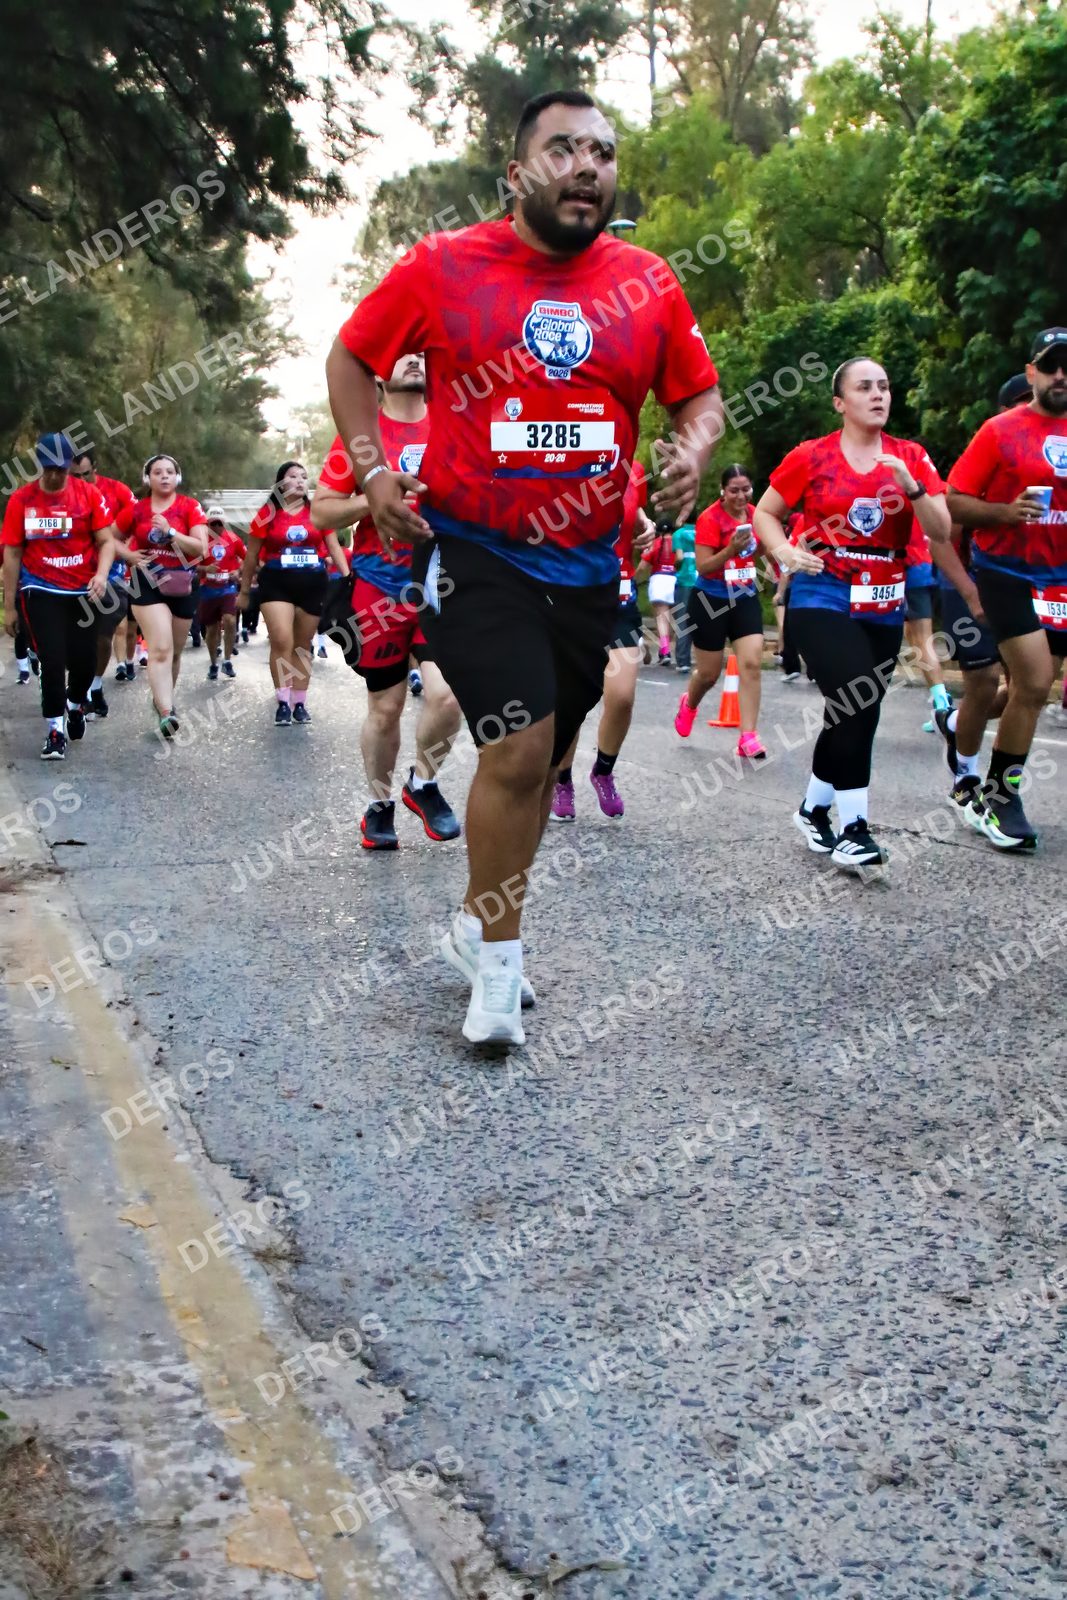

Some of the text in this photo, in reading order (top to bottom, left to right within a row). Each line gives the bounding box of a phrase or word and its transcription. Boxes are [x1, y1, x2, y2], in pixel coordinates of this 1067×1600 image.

[540, 306, 575, 317] BIMBO
[540, 319, 575, 332] Global
[533, 328, 561, 341] Race
[548, 368, 568, 378] 2026
[527, 424, 581, 448] 3285
[39, 518, 58, 528] 2168
[872, 585, 896, 601] 3454
